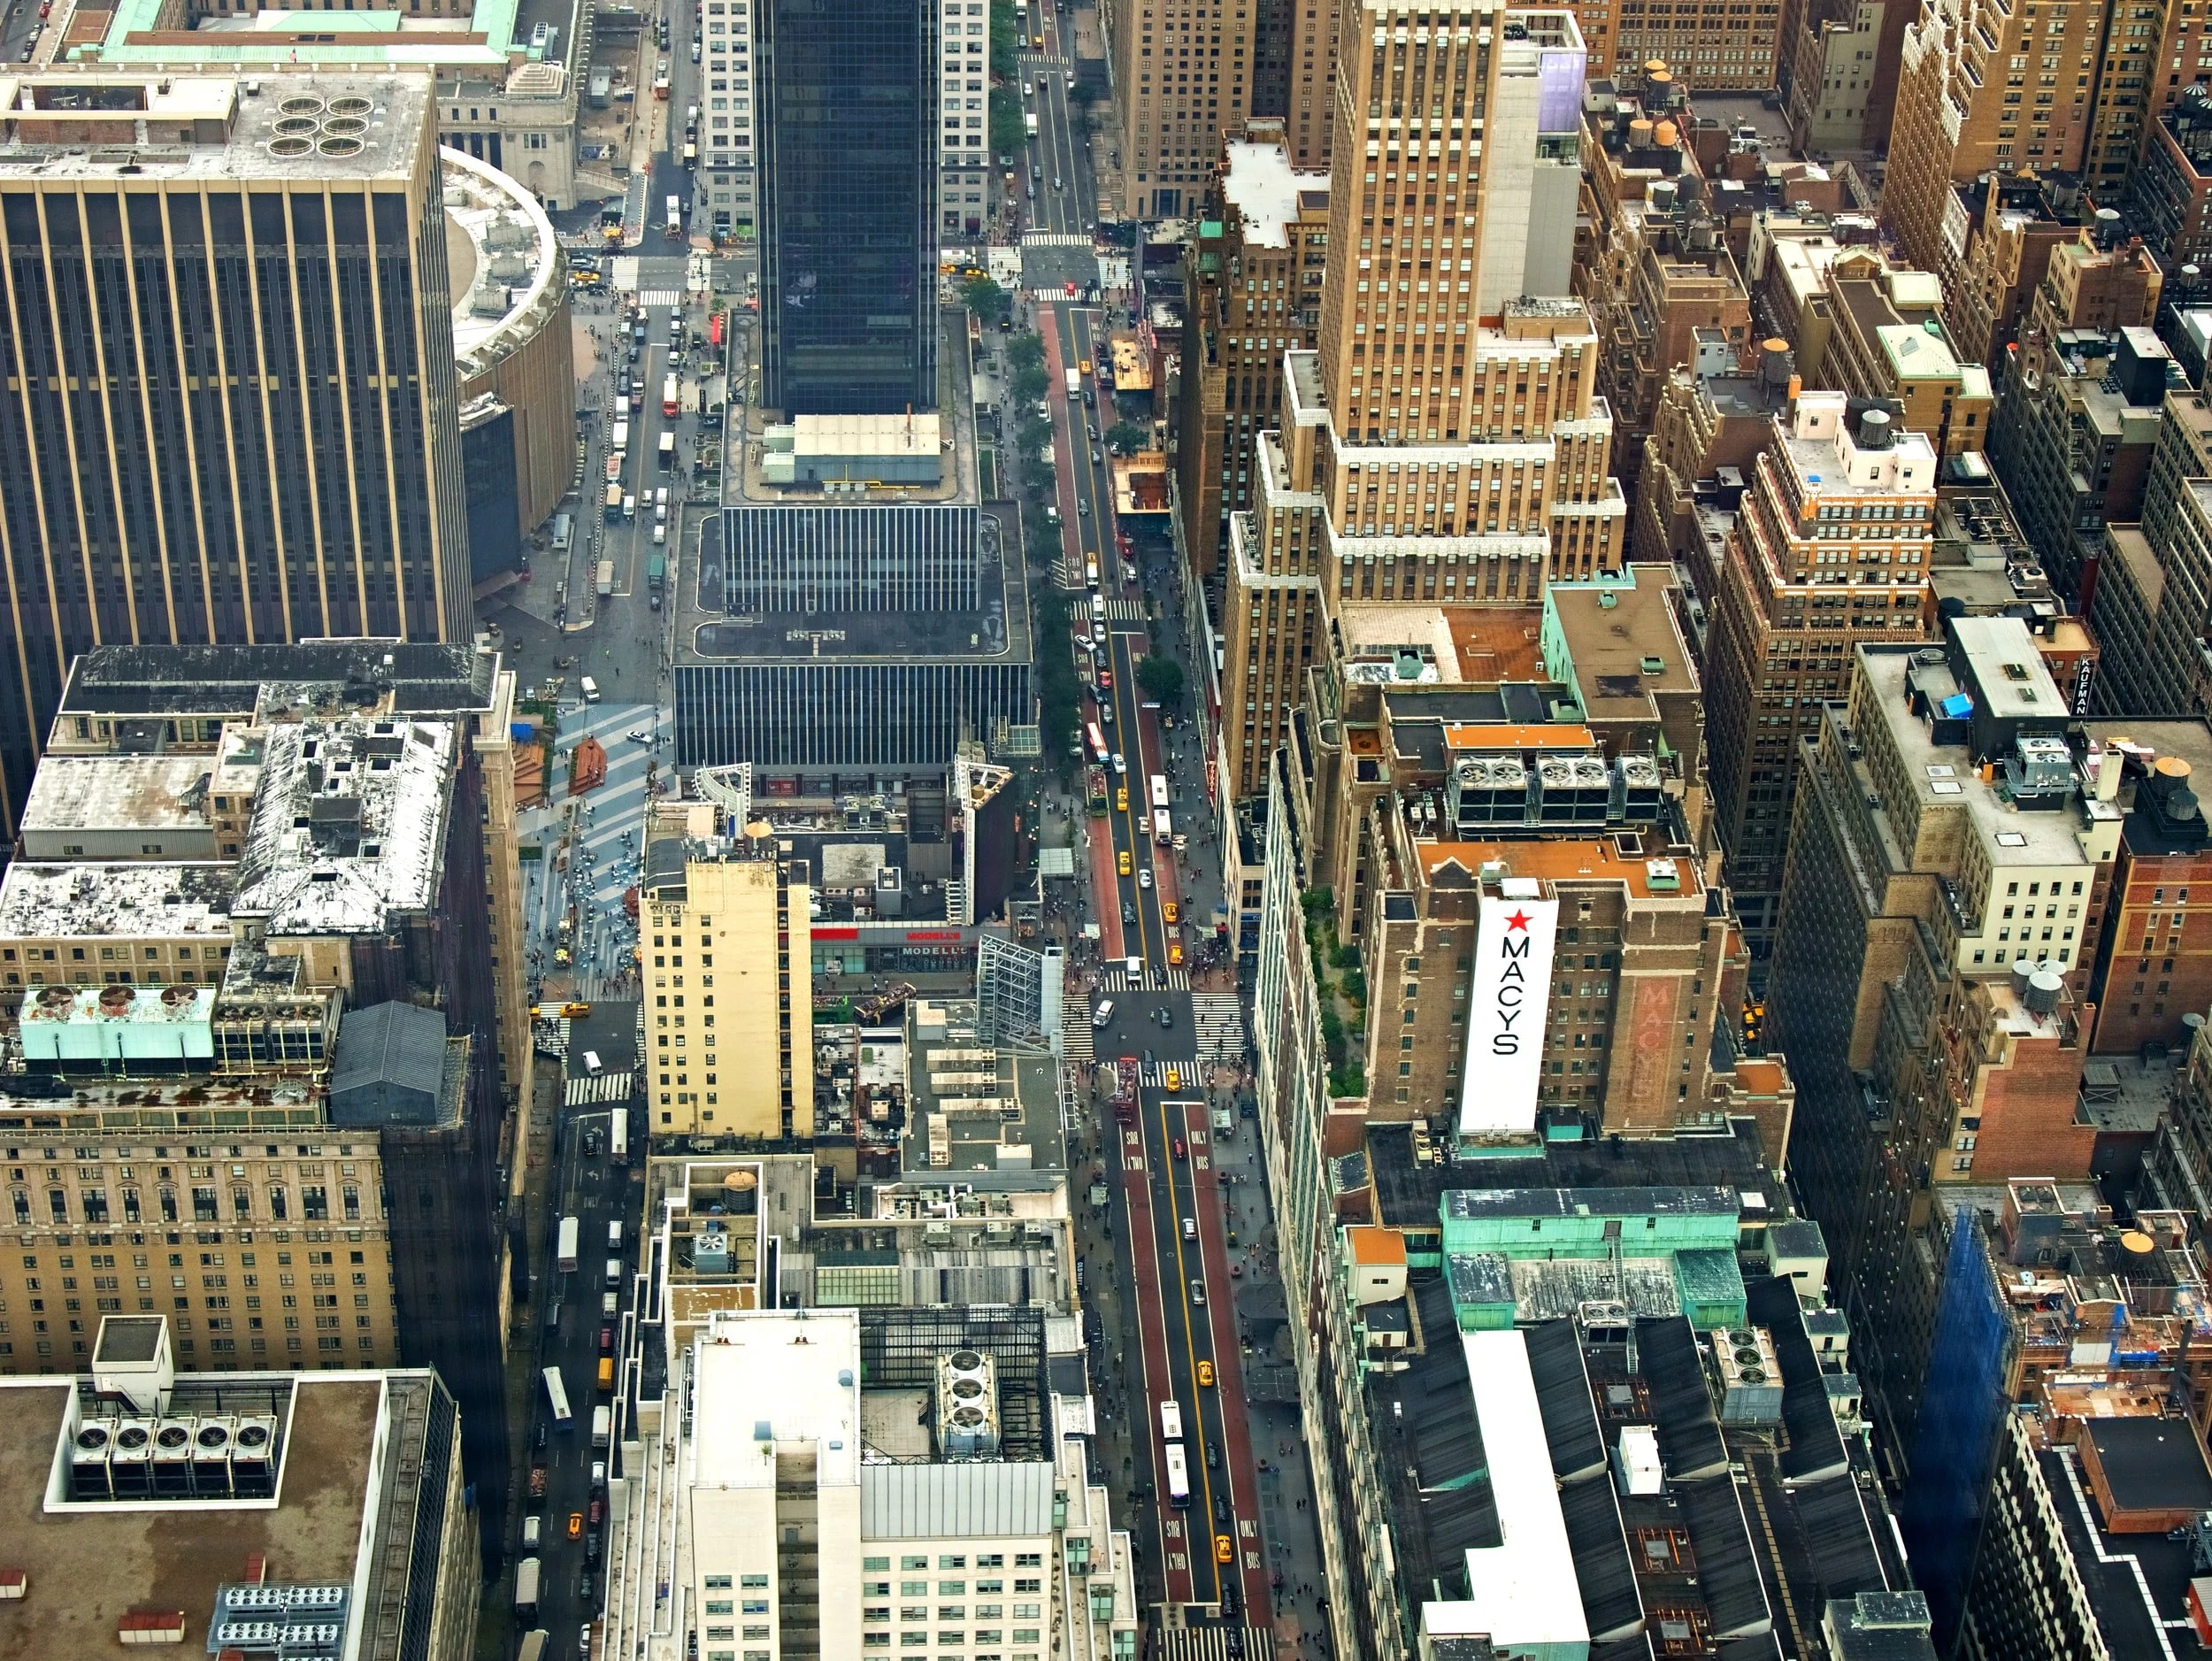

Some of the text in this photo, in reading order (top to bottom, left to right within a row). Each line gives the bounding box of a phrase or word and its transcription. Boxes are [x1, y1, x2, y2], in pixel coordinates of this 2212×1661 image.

[2076, 658, 2091, 715] KAUFMAN
[1168, 926, 1180, 938] BUS
[902, 947, 968, 956] MODELL'S
[1125, 1131, 1139, 1145] BUS
[1191, 1131, 1207, 1144] ONLY
[1127, 1156, 1143, 1170] ONLY
[1195, 1156, 1210, 1170] BUS
[584, 1196, 600, 1209] ONLY
[1166, 1520, 1180, 1538] BUS
[1240, 1520, 1258, 1537] ONLY
[1168, 1552, 1187, 1570] ONLY
[1246, 1551, 1261, 1569] BUS
